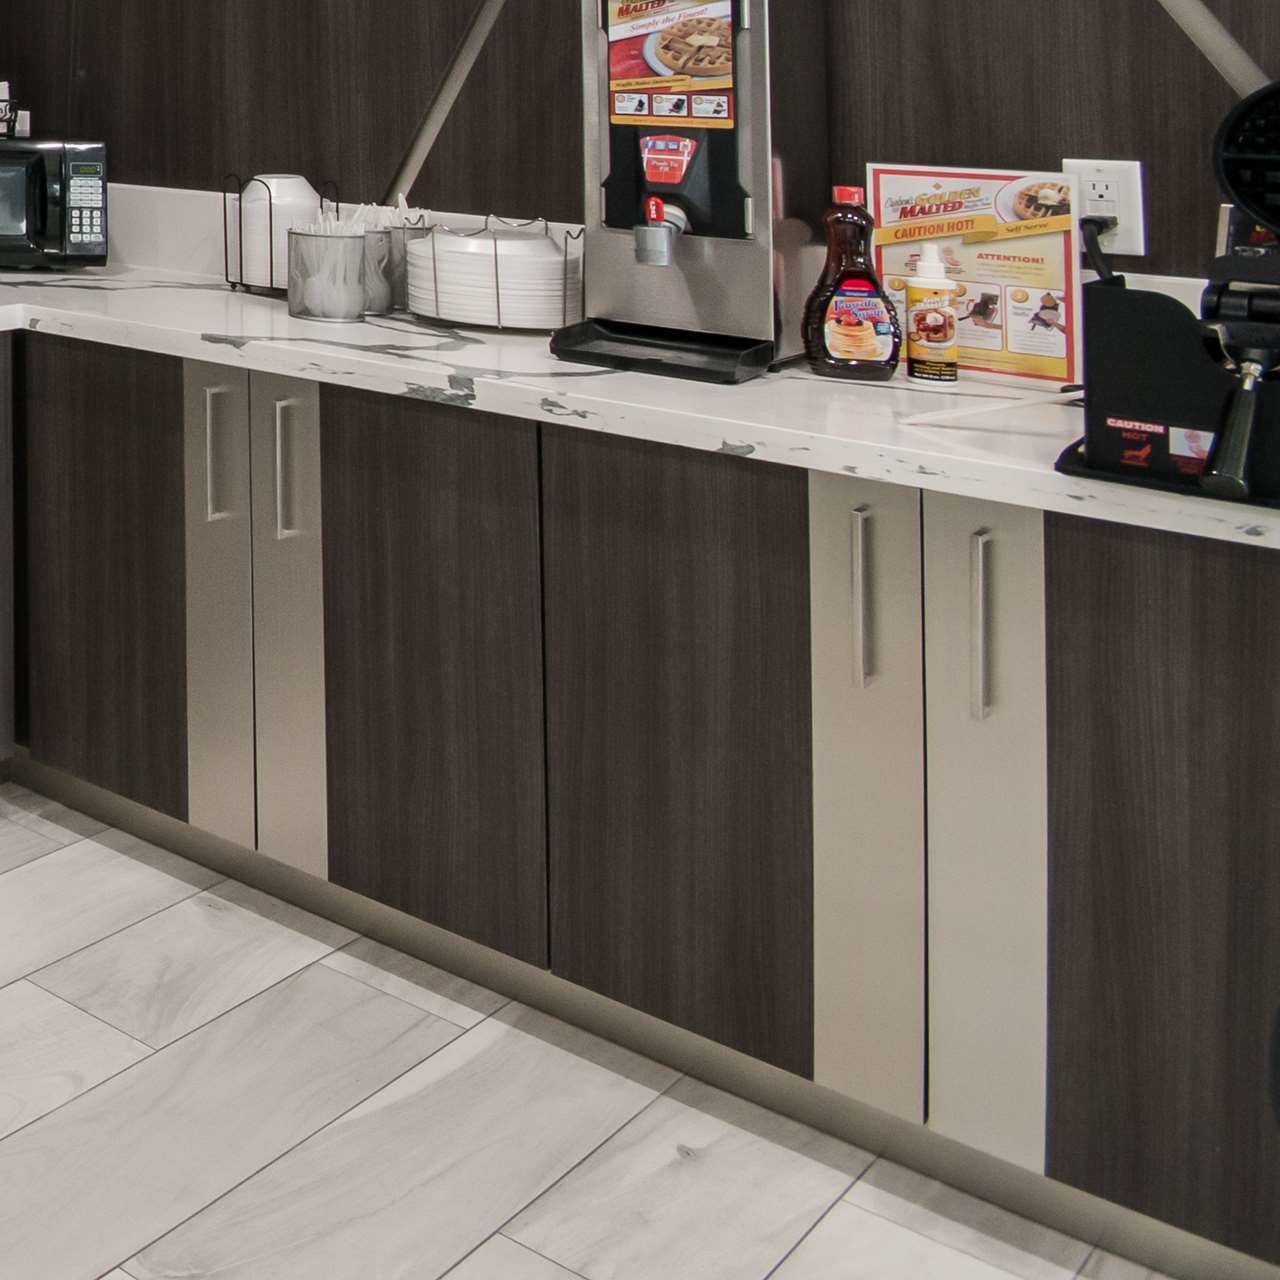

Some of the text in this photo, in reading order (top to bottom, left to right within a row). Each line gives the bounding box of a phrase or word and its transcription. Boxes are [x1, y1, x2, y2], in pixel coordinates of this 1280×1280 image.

[915, 187, 981, 206] GOLDEN
[899, 200, 964, 219] MALTED
[894, 219, 975, 240] CAUTION HOT!
[976, 252, 1045, 265] ATTENTION!
[1106, 417, 1165, 433] CAUTION
[1121, 431, 1150, 441] HOT
